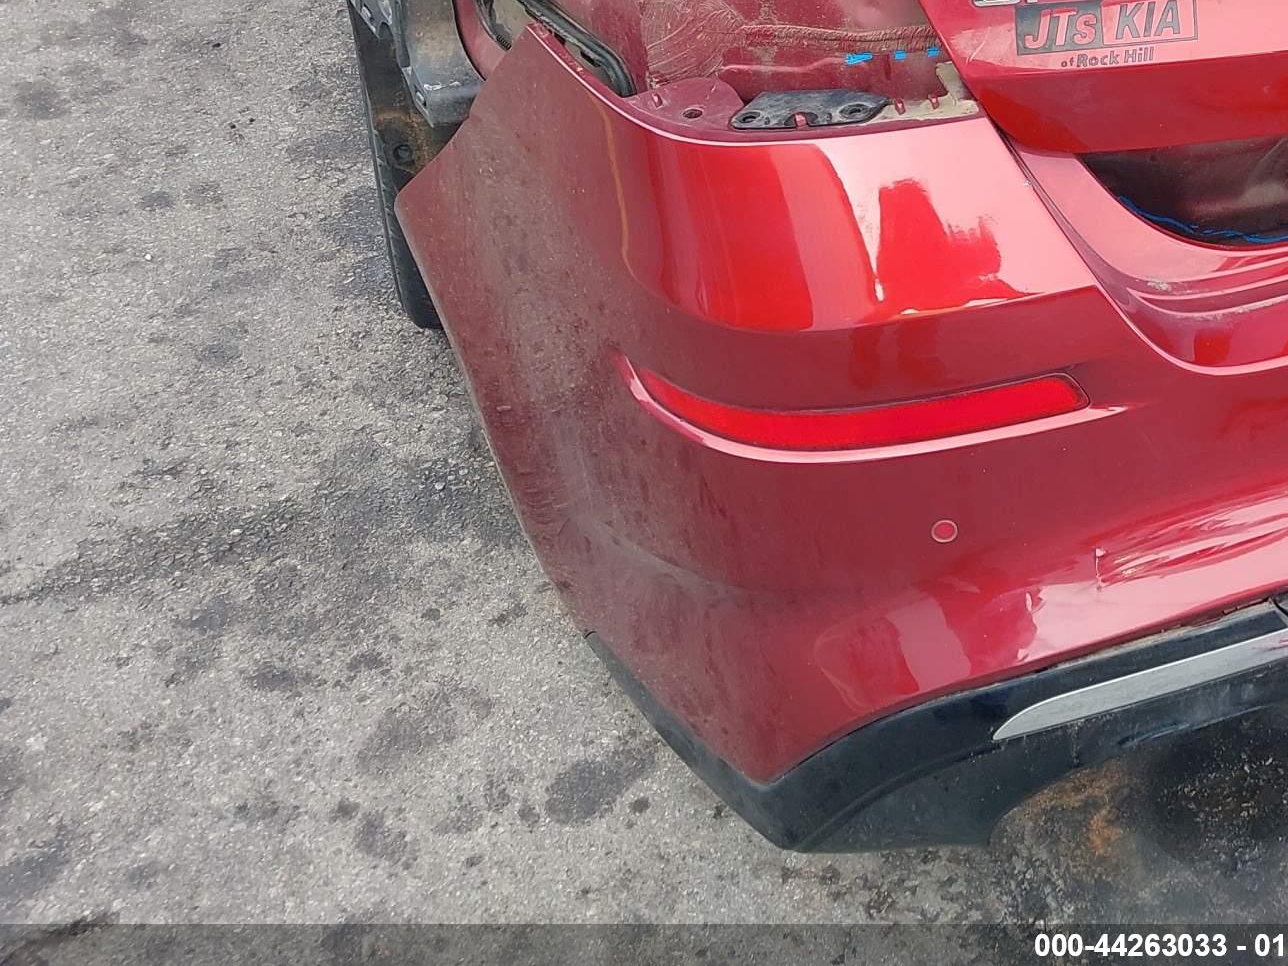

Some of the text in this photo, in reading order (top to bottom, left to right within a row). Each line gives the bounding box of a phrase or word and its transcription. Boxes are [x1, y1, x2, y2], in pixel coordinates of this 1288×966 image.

[1023, 0, 1181, 50] JTs KIA
[1061, 46, 1154, 68] of Rock Hill
